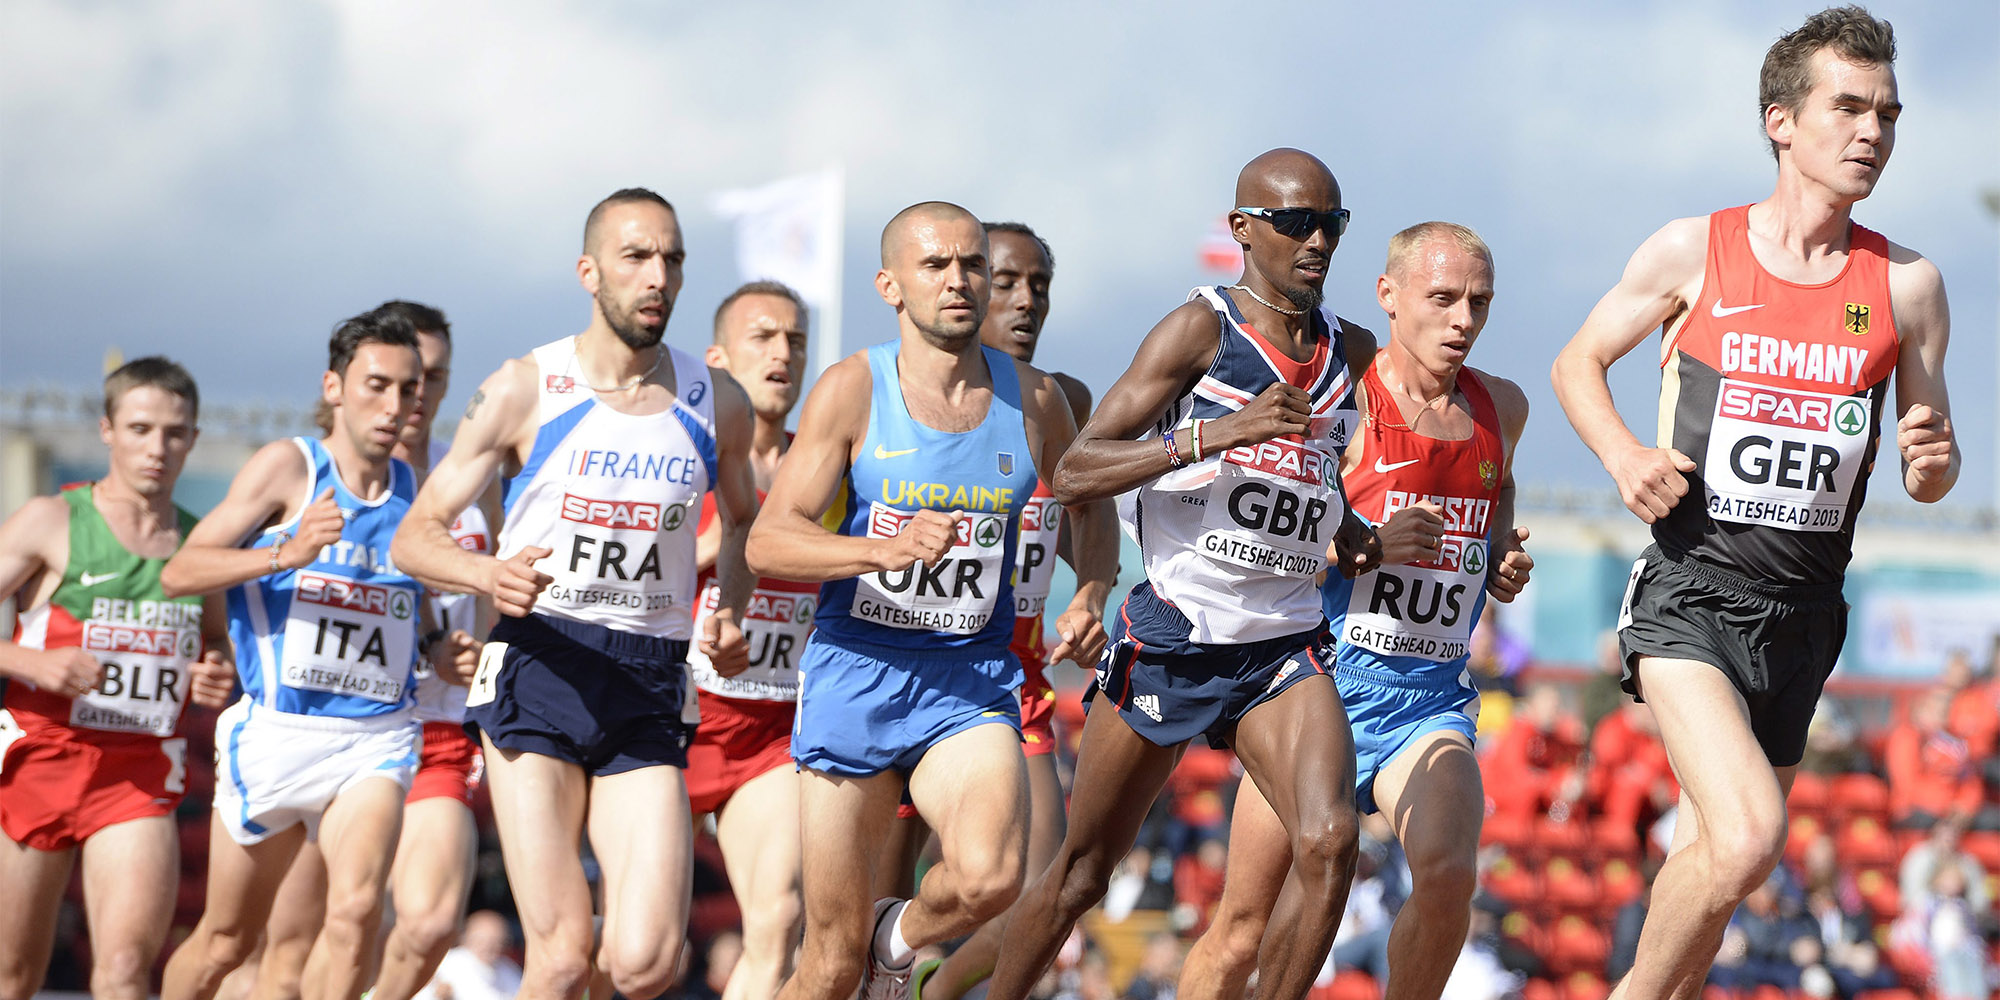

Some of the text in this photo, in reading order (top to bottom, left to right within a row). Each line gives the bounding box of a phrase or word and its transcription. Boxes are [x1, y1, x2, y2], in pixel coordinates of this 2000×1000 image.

[1720, 331, 1869, 386] GERMANY
[1722, 388, 1830, 427] SPAR
[583, 450, 696, 485] FRANCE
[1228, 442, 1322, 481] SPAR
[1729, 435, 1841, 493] GER
[563, 496, 658, 530] SPAR
[881, 478, 1014, 513] UKRAINE
[1227, 481, 1328, 544] GBR
[1708, 495, 1839, 527] GATESHEAD 2013
[873, 511, 971, 544] SR
[569, 534, 662, 581] FRA
[1205, 534, 1319, 576] GATESHEAD 2013
[300, 576, 388, 612] SPAR
[550, 584, 673, 610] GATESHEAD 2013
[1368, 571, 1466, 628] RUS
[859, 600, 987, 630] GATESHEAD 2013
[89, 627, 176, 656] SPAR
[314, 617, 387, 667] ITA
[745, 630, 795, 669] UR
[1350, 625, 1465, 660] GATESHEAD 2013
[98, 661, 180, 703] BLR
[288, 665, 370, 692] GATESHEAD
[478, 654, 492, 694] 4
[1133, 696, 1163, 723] adidas
